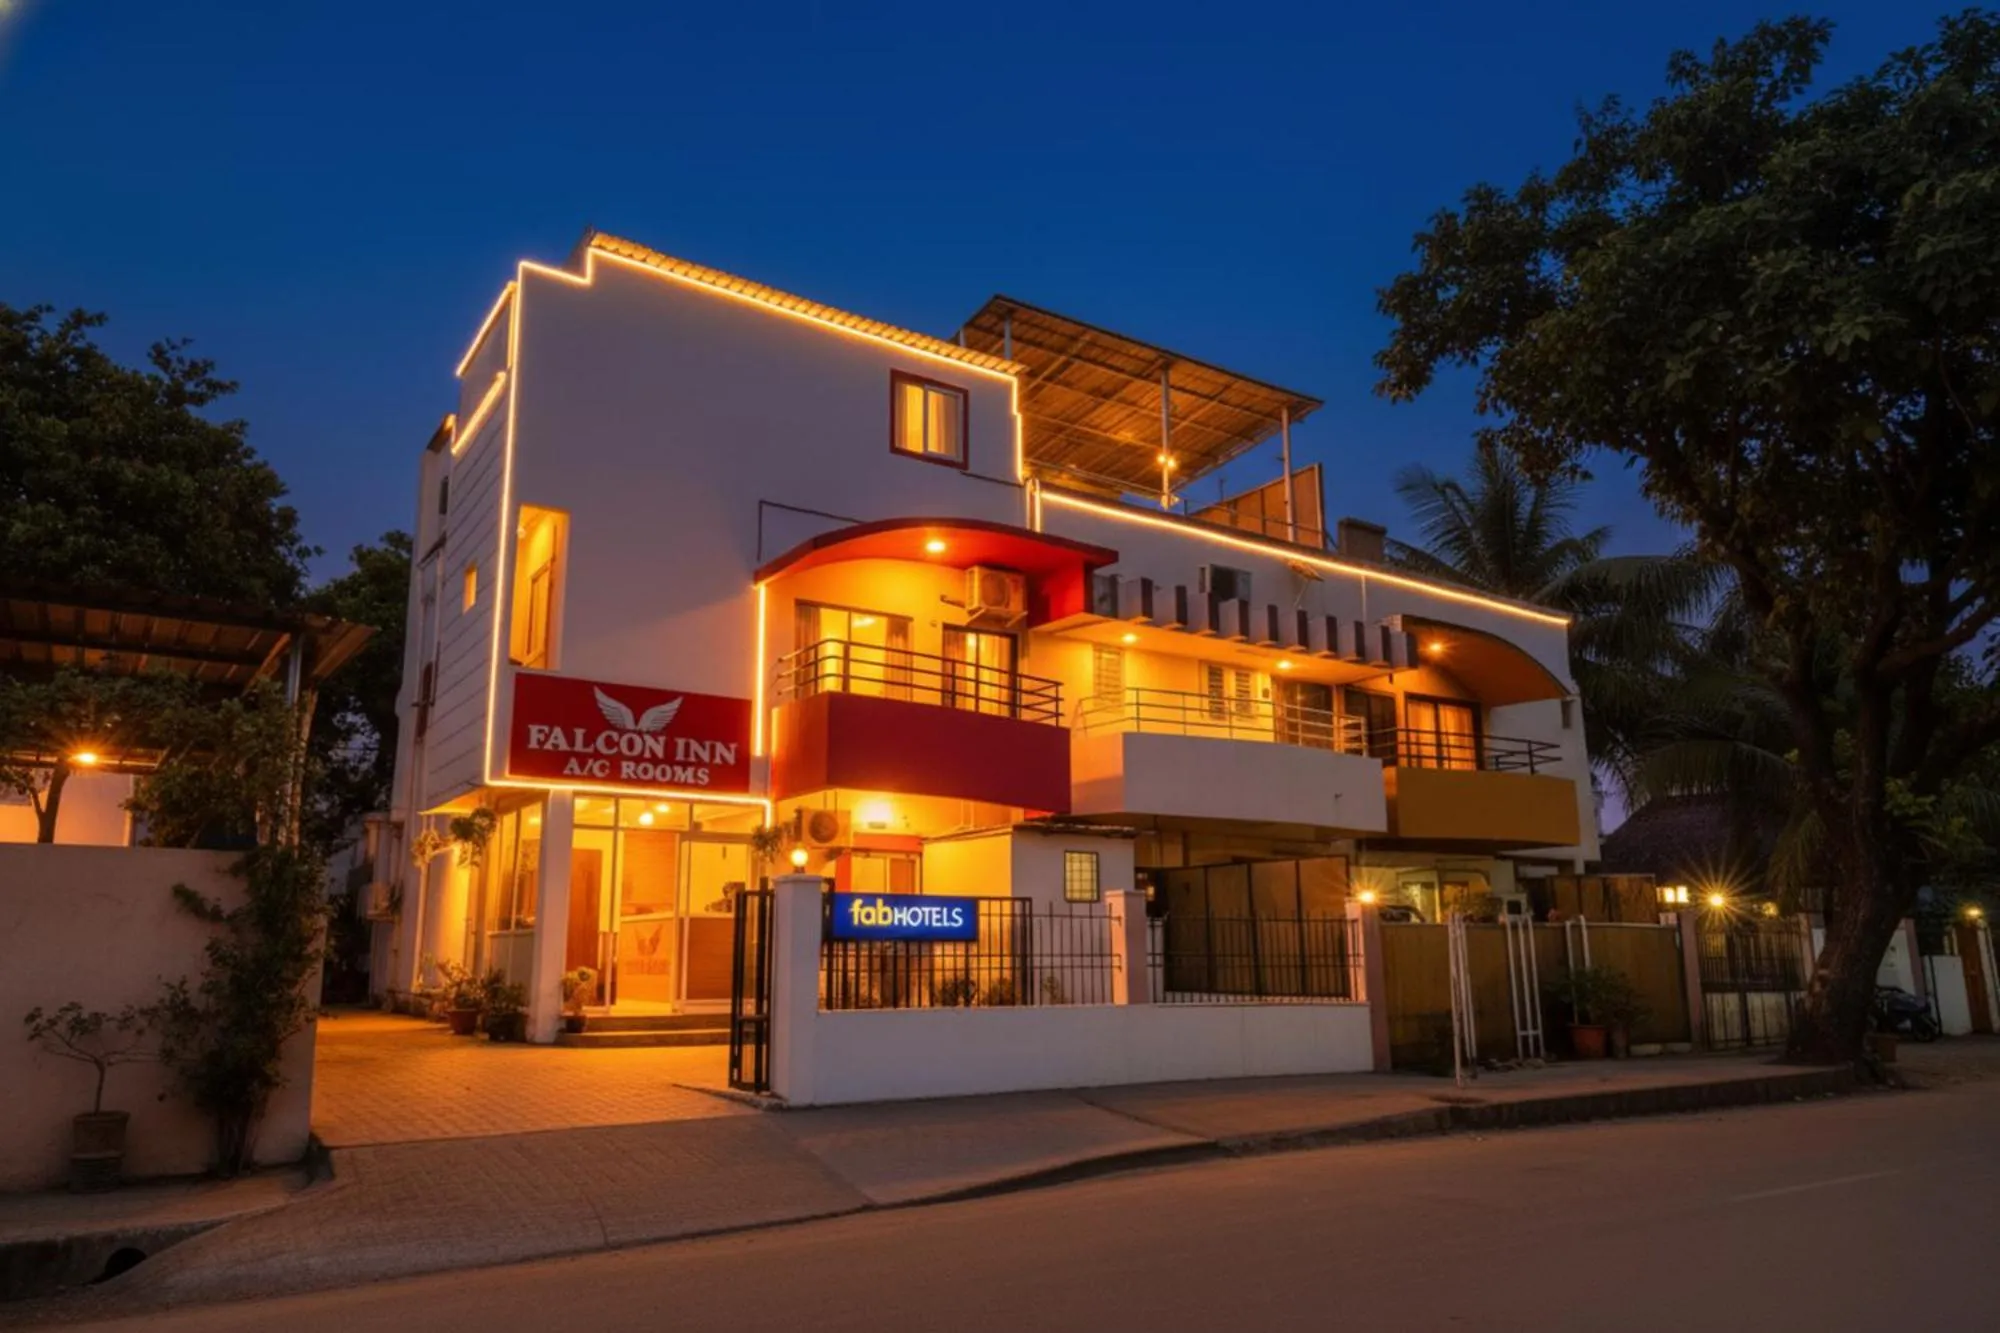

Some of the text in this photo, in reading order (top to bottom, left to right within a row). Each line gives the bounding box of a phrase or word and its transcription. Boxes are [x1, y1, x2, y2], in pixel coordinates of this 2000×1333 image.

[528, 724, 737, 765] FALCON INN
[563, 757, 710, 785] A/C ROOMS
